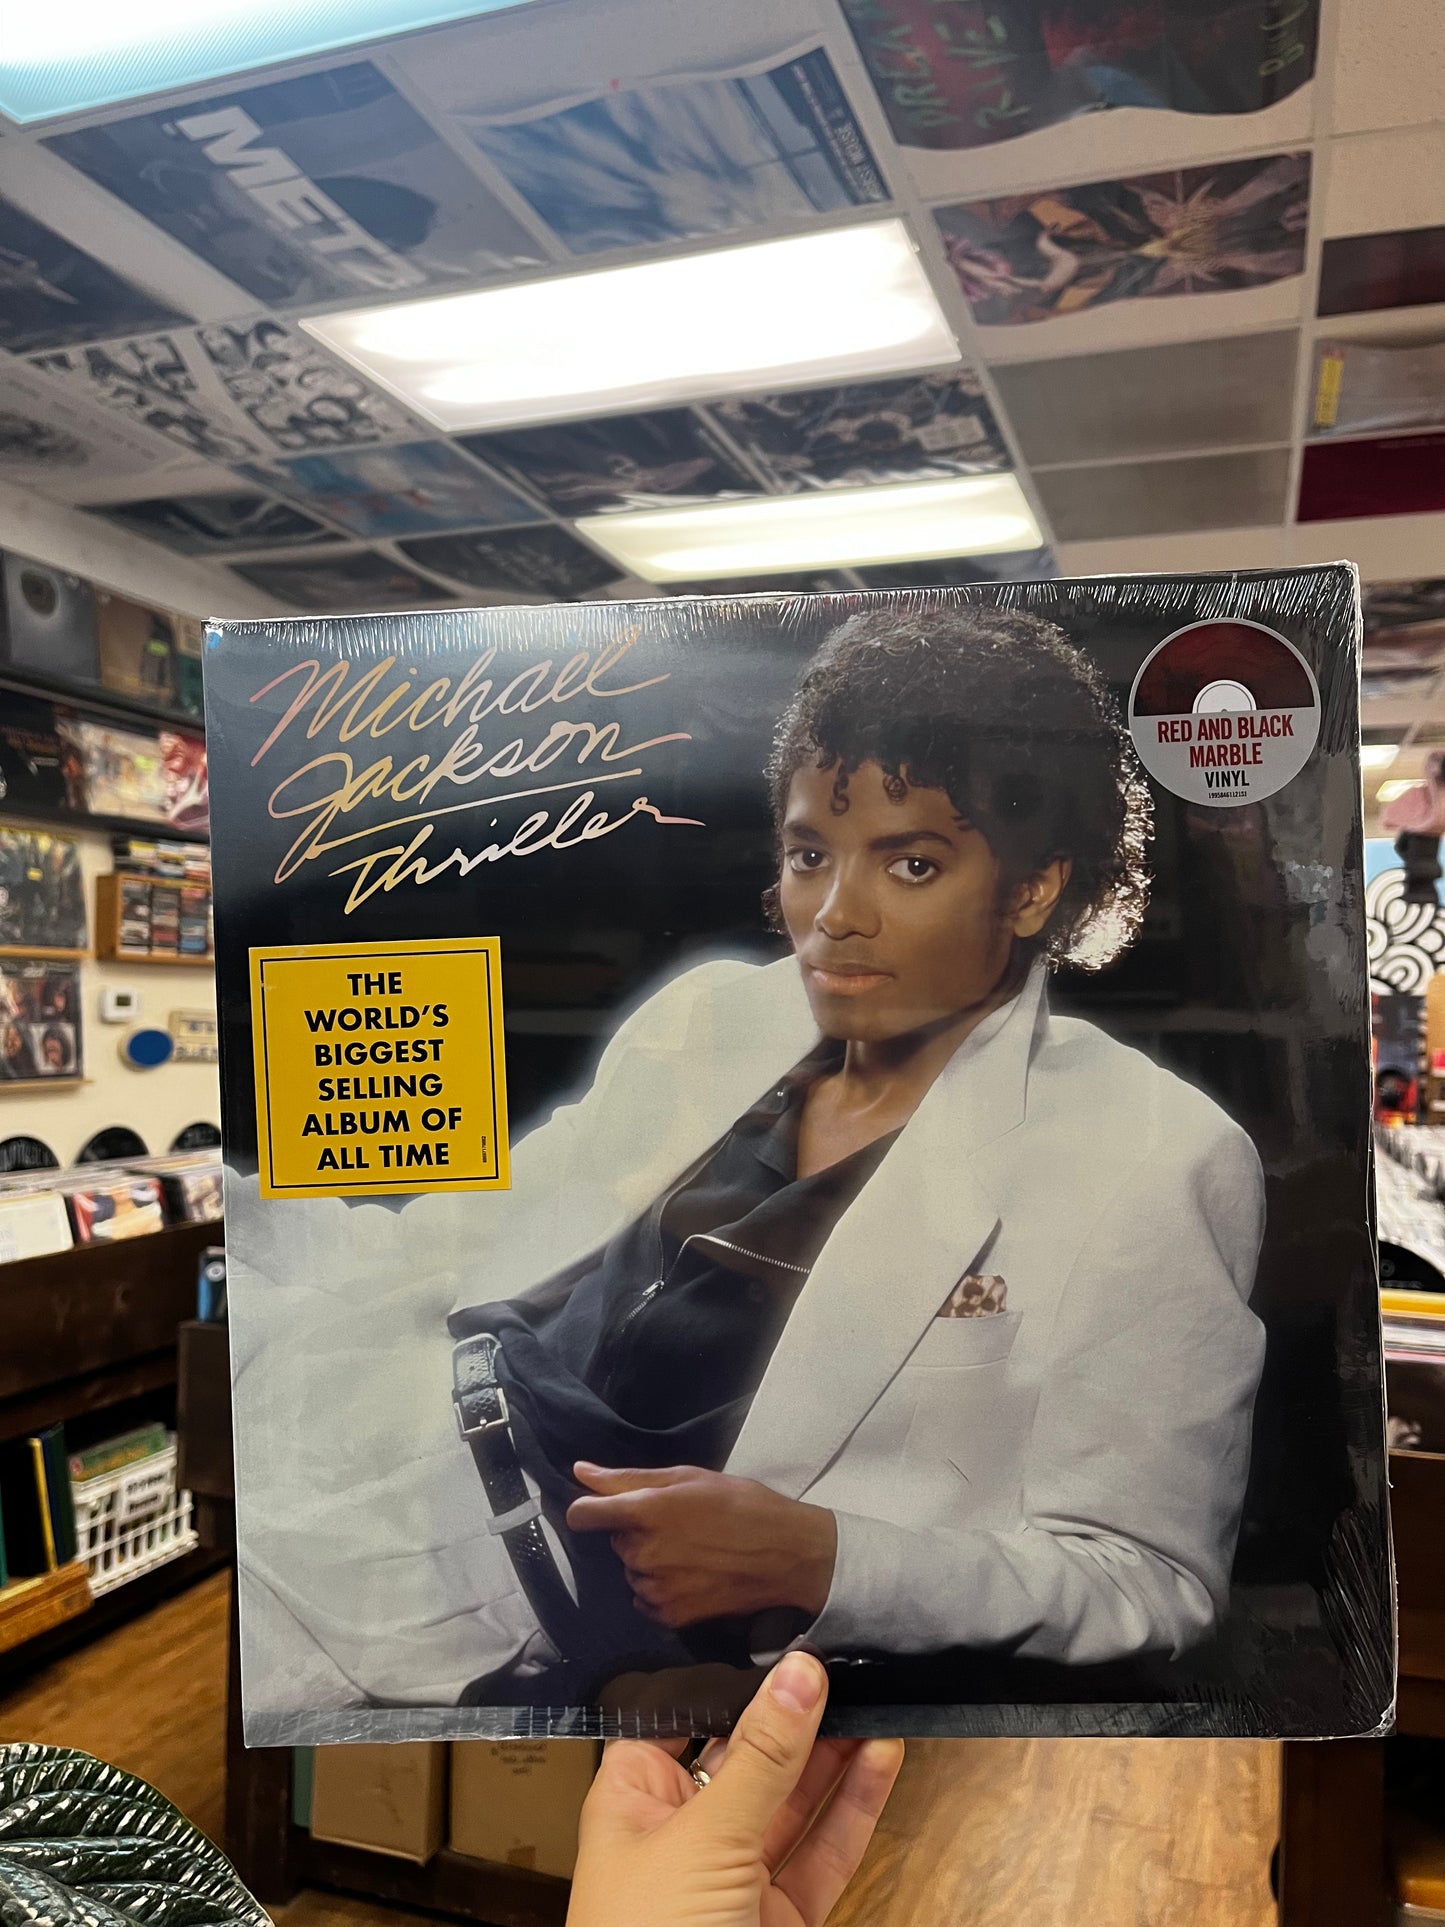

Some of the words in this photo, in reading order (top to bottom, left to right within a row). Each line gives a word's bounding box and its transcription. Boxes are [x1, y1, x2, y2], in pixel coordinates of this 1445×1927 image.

[249, 624, 671, 767] Michael
[1157, 720, 1193, 743] RED
[1197, 718, 1232, 741] AND
[1237, 714, 1294, 739] BLACK
[1189, 742, 1263, 768] MARBLE
[1204, 770, 1250, 788] VINYL
[267, 720, 692, 884] Jackson
[328, 790, 706, 914] Thriller
[347, 972, 403, 996] THE
[304, 1004, 449, 1032] WORLD'S
[314, 1039, 444, 1067] BIGGEST
[318, 1073, 443, 1101] SELLING
[301, 1110, 410, 1136] ALBUM
[421, 1107, 462, 1132] OF
[317, 1147, 370, 1171] ALL
[379, 1143, 450, 1168] TIME
